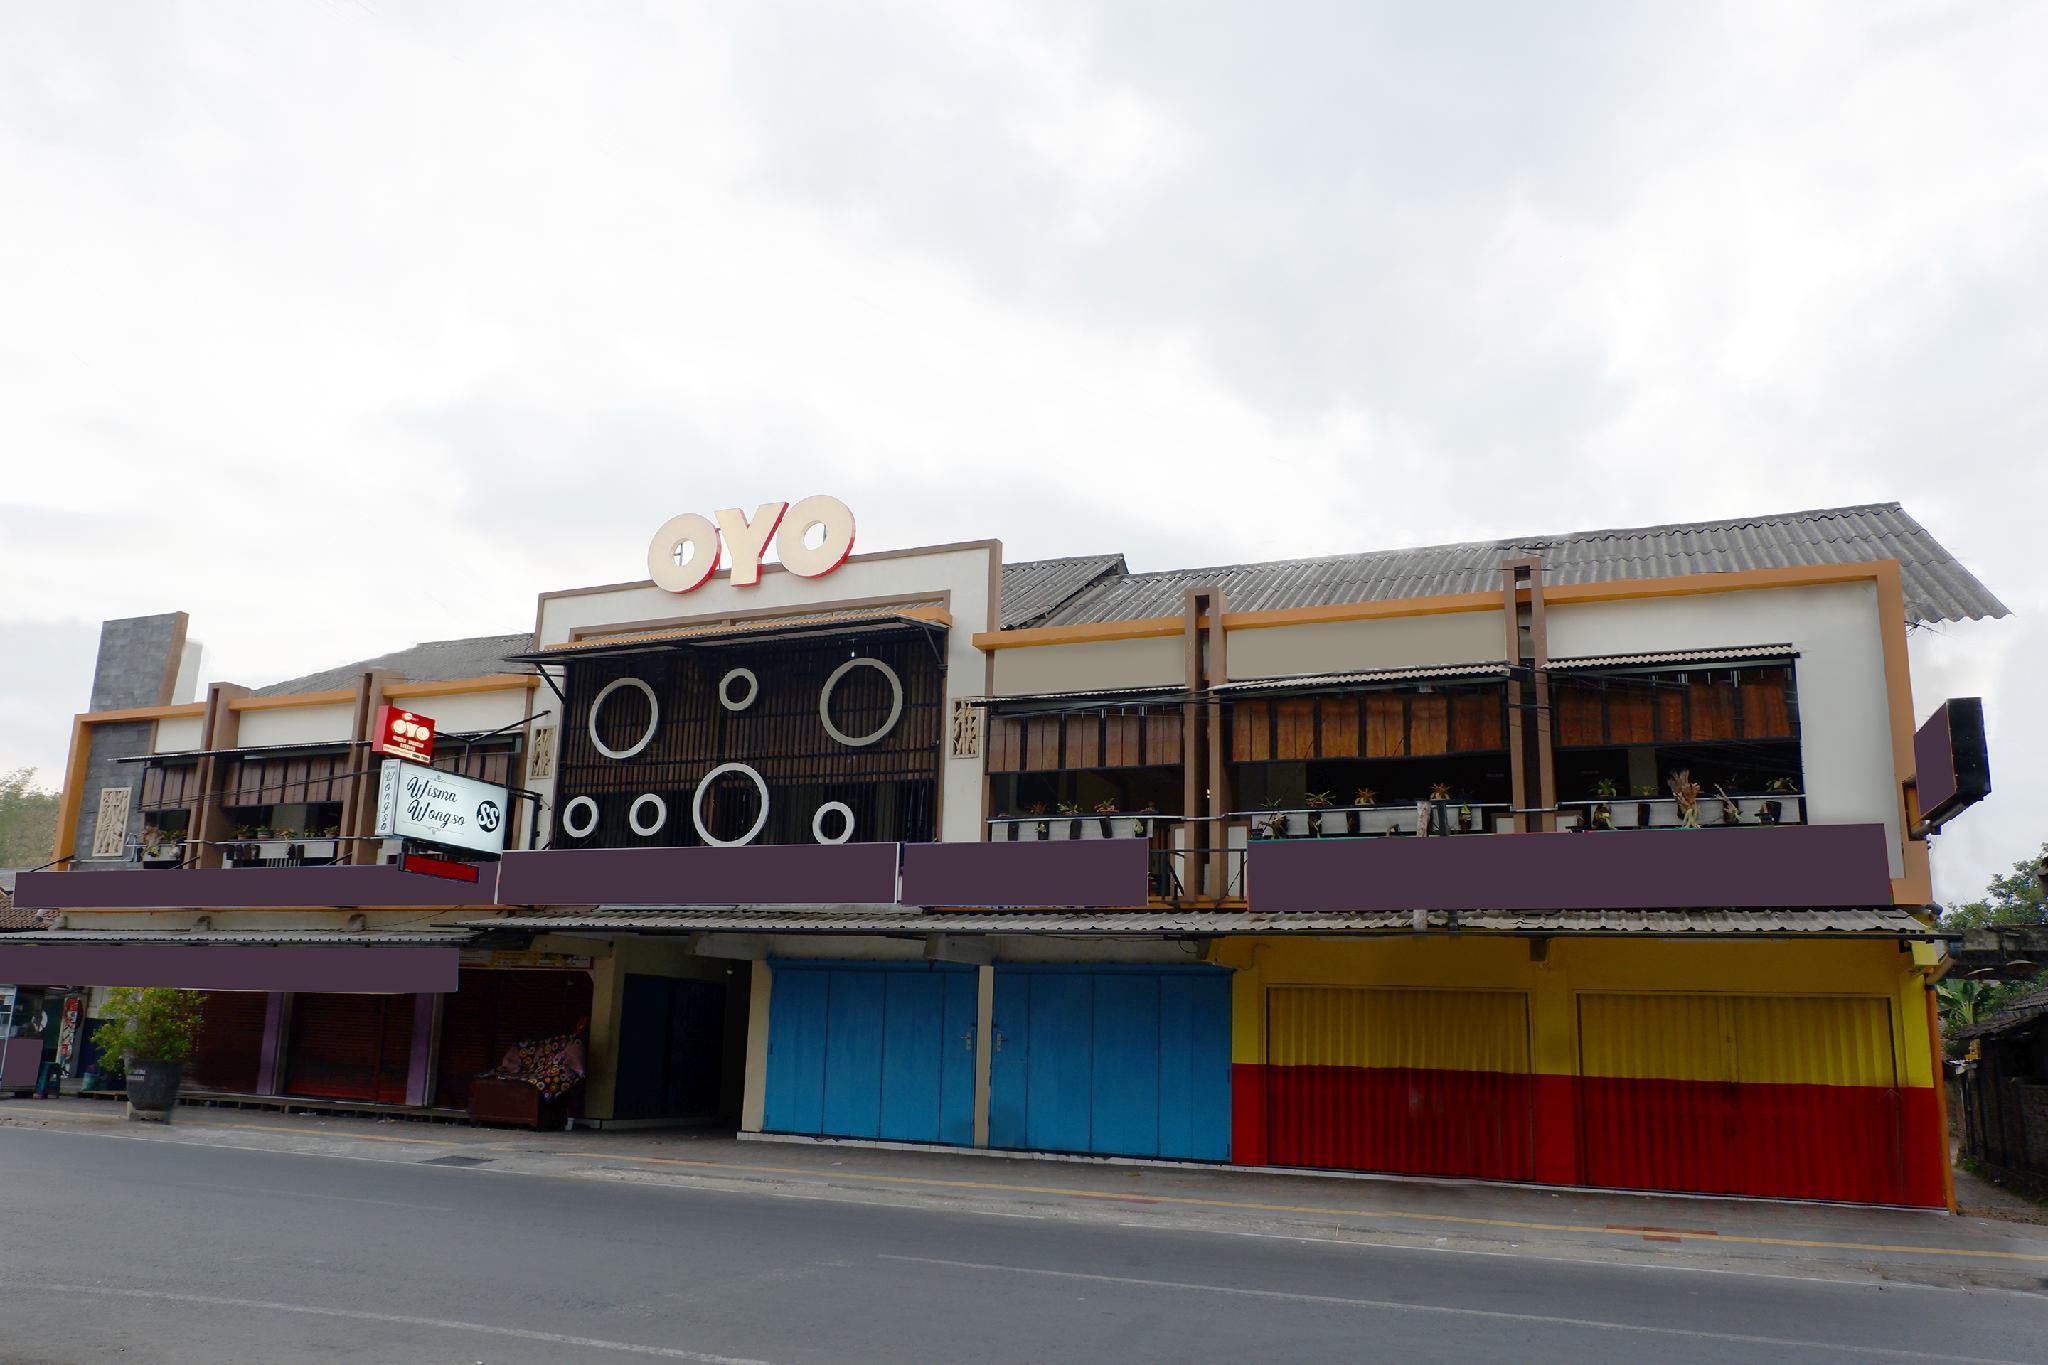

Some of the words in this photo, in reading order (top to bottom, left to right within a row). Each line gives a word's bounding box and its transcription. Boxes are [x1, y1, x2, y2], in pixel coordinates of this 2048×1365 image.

[648, 495, 856, 594] OYO
[392, 719, 430, 741] OYO
[406, 776, 457, 803] Wisma
[406, 799, 465, 829] Wongso
